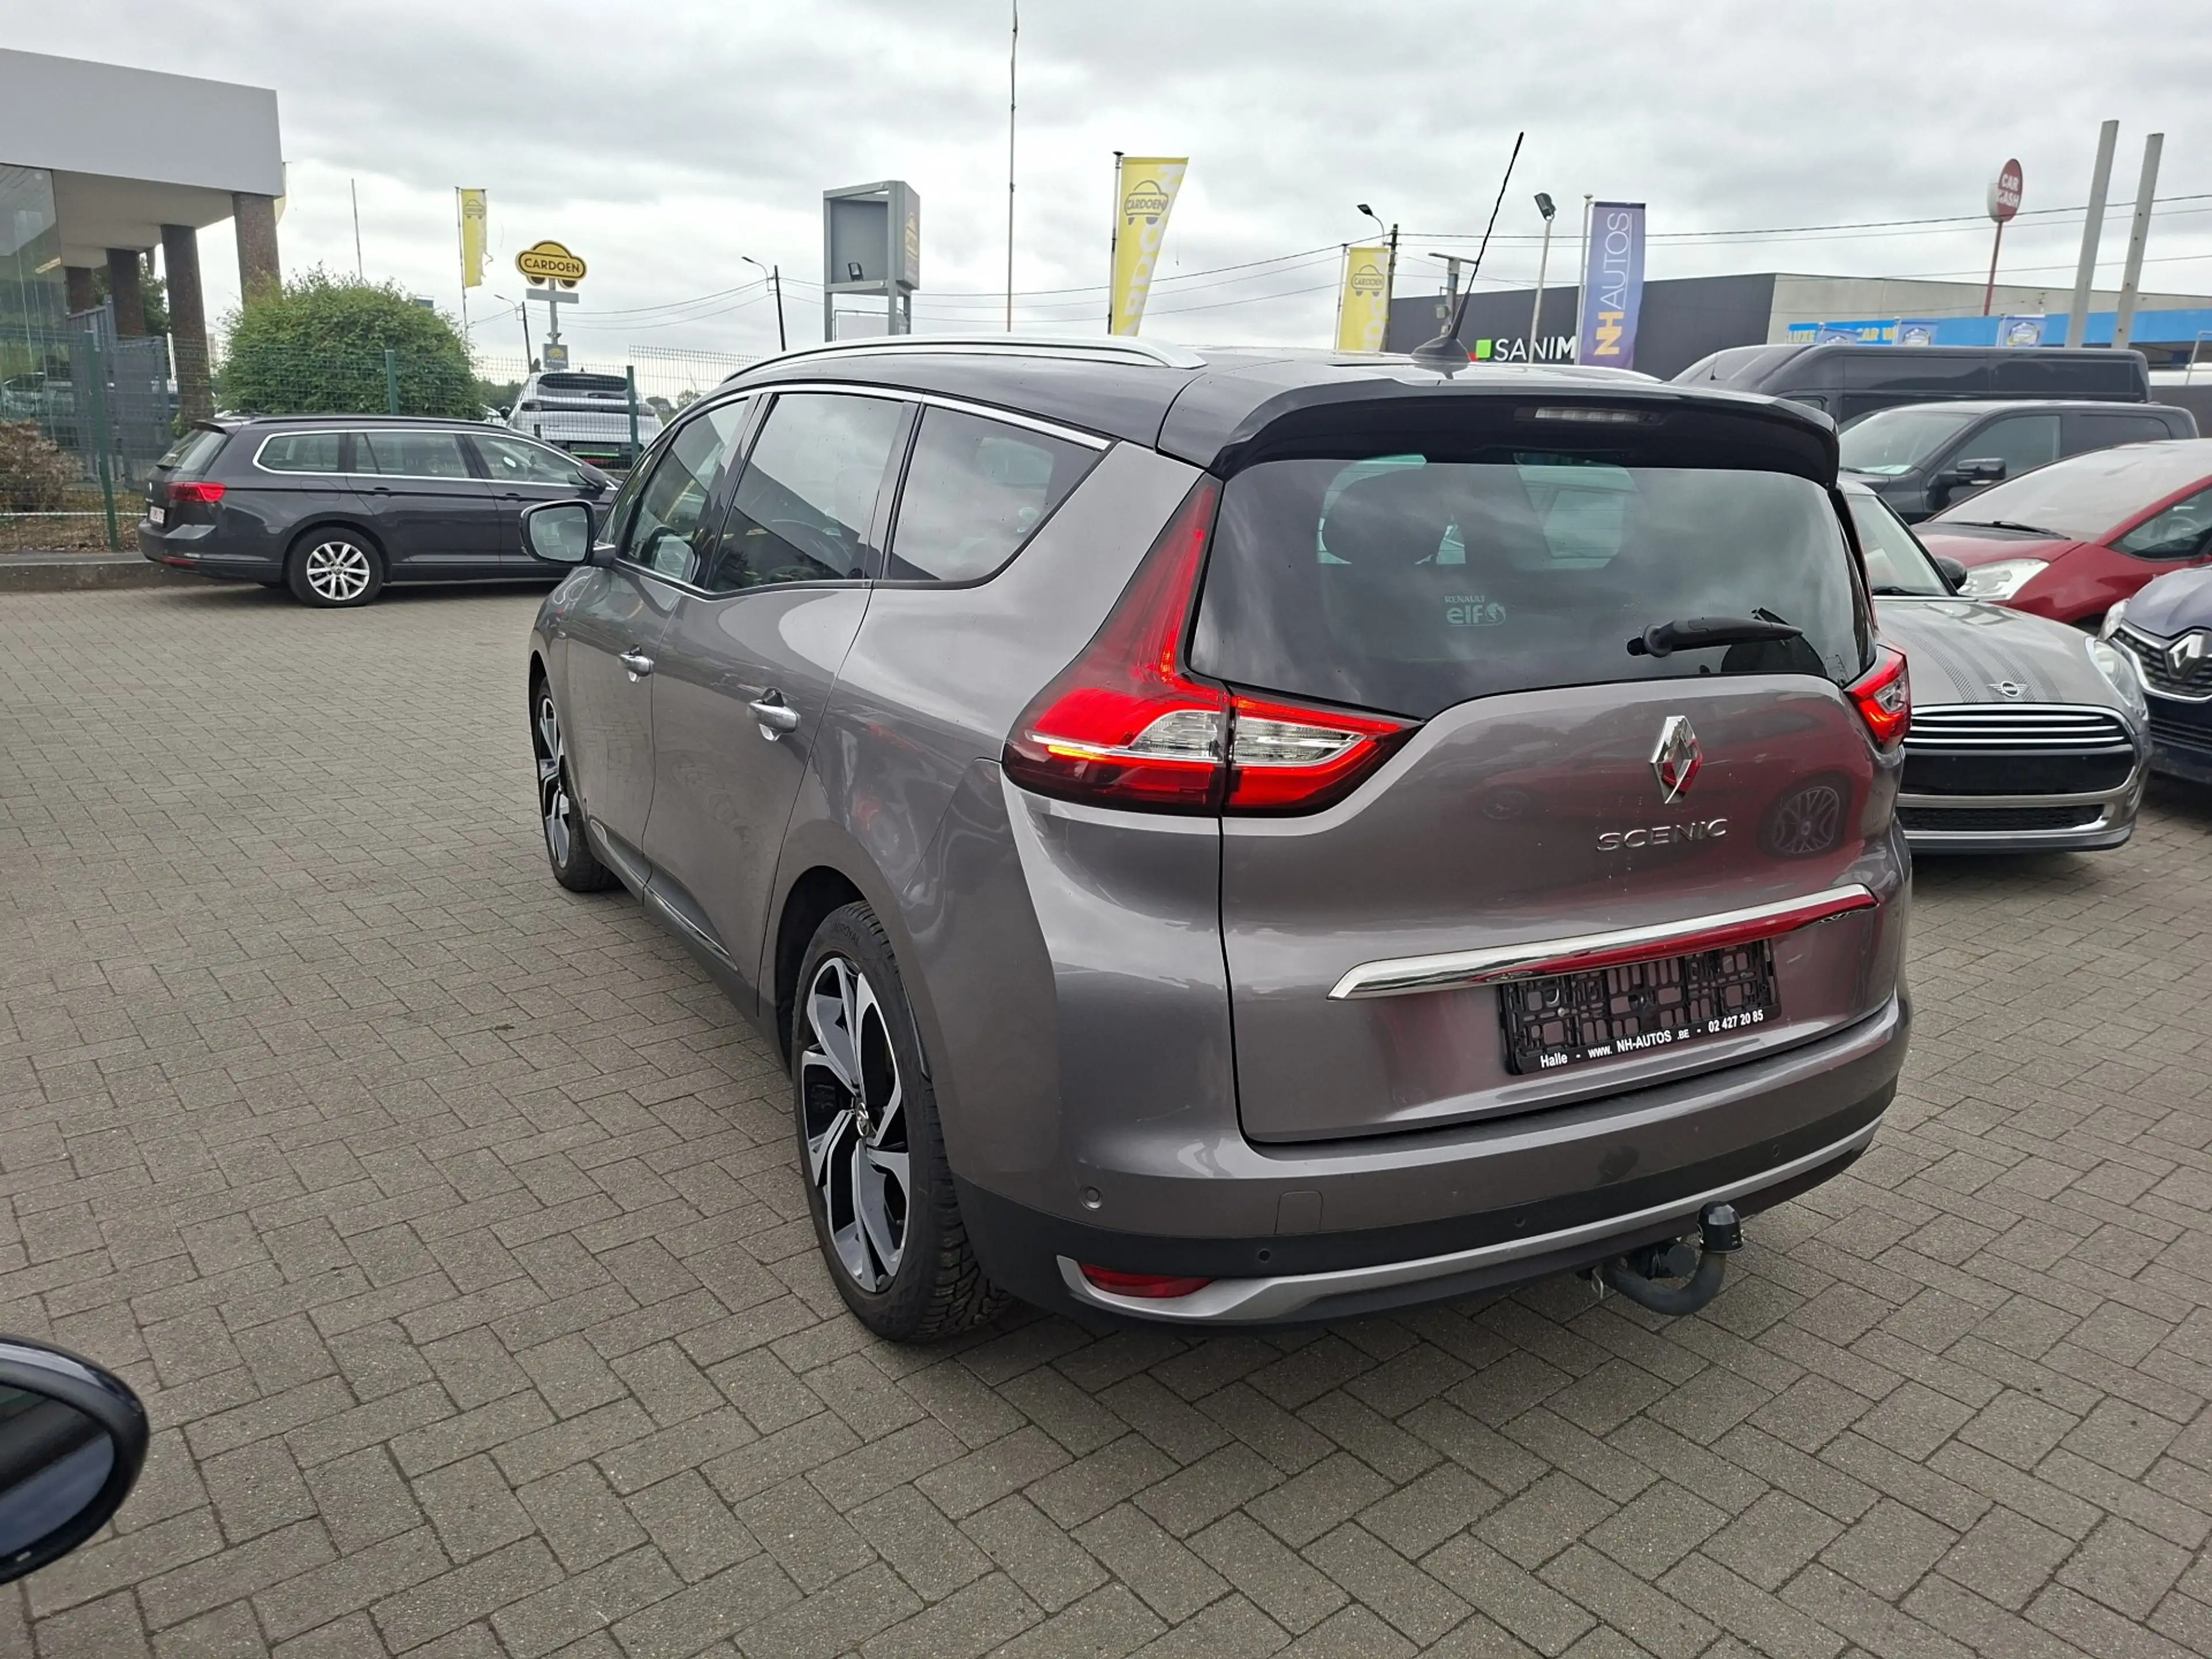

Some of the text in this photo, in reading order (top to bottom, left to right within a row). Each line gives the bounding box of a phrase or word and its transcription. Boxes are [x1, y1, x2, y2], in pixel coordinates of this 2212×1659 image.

[2002, 173, 2019, 191] CAR
[524, 257, 580, 273] CARDOEN
[1600, 213, 1630, 310] AUTOS
[1445, 595, 1485, 603] RENAULT
[1447, 605, 1484, 624] elf
[1596, 819, 1728, 852] SCENIC
[1540, 1052, 1567, 1068] Halle
[1588, 1045, 1613, 1059] www.
[1616, 1029, 1672, 1053] NH-AUTOS
[1709, 1019, 1720, 1033] 02
[1721, 1014, 1738, 1030] 427
[1740, 1012, 1751, 1026] 20
[1752, 1009, 1764, 1022] 85
